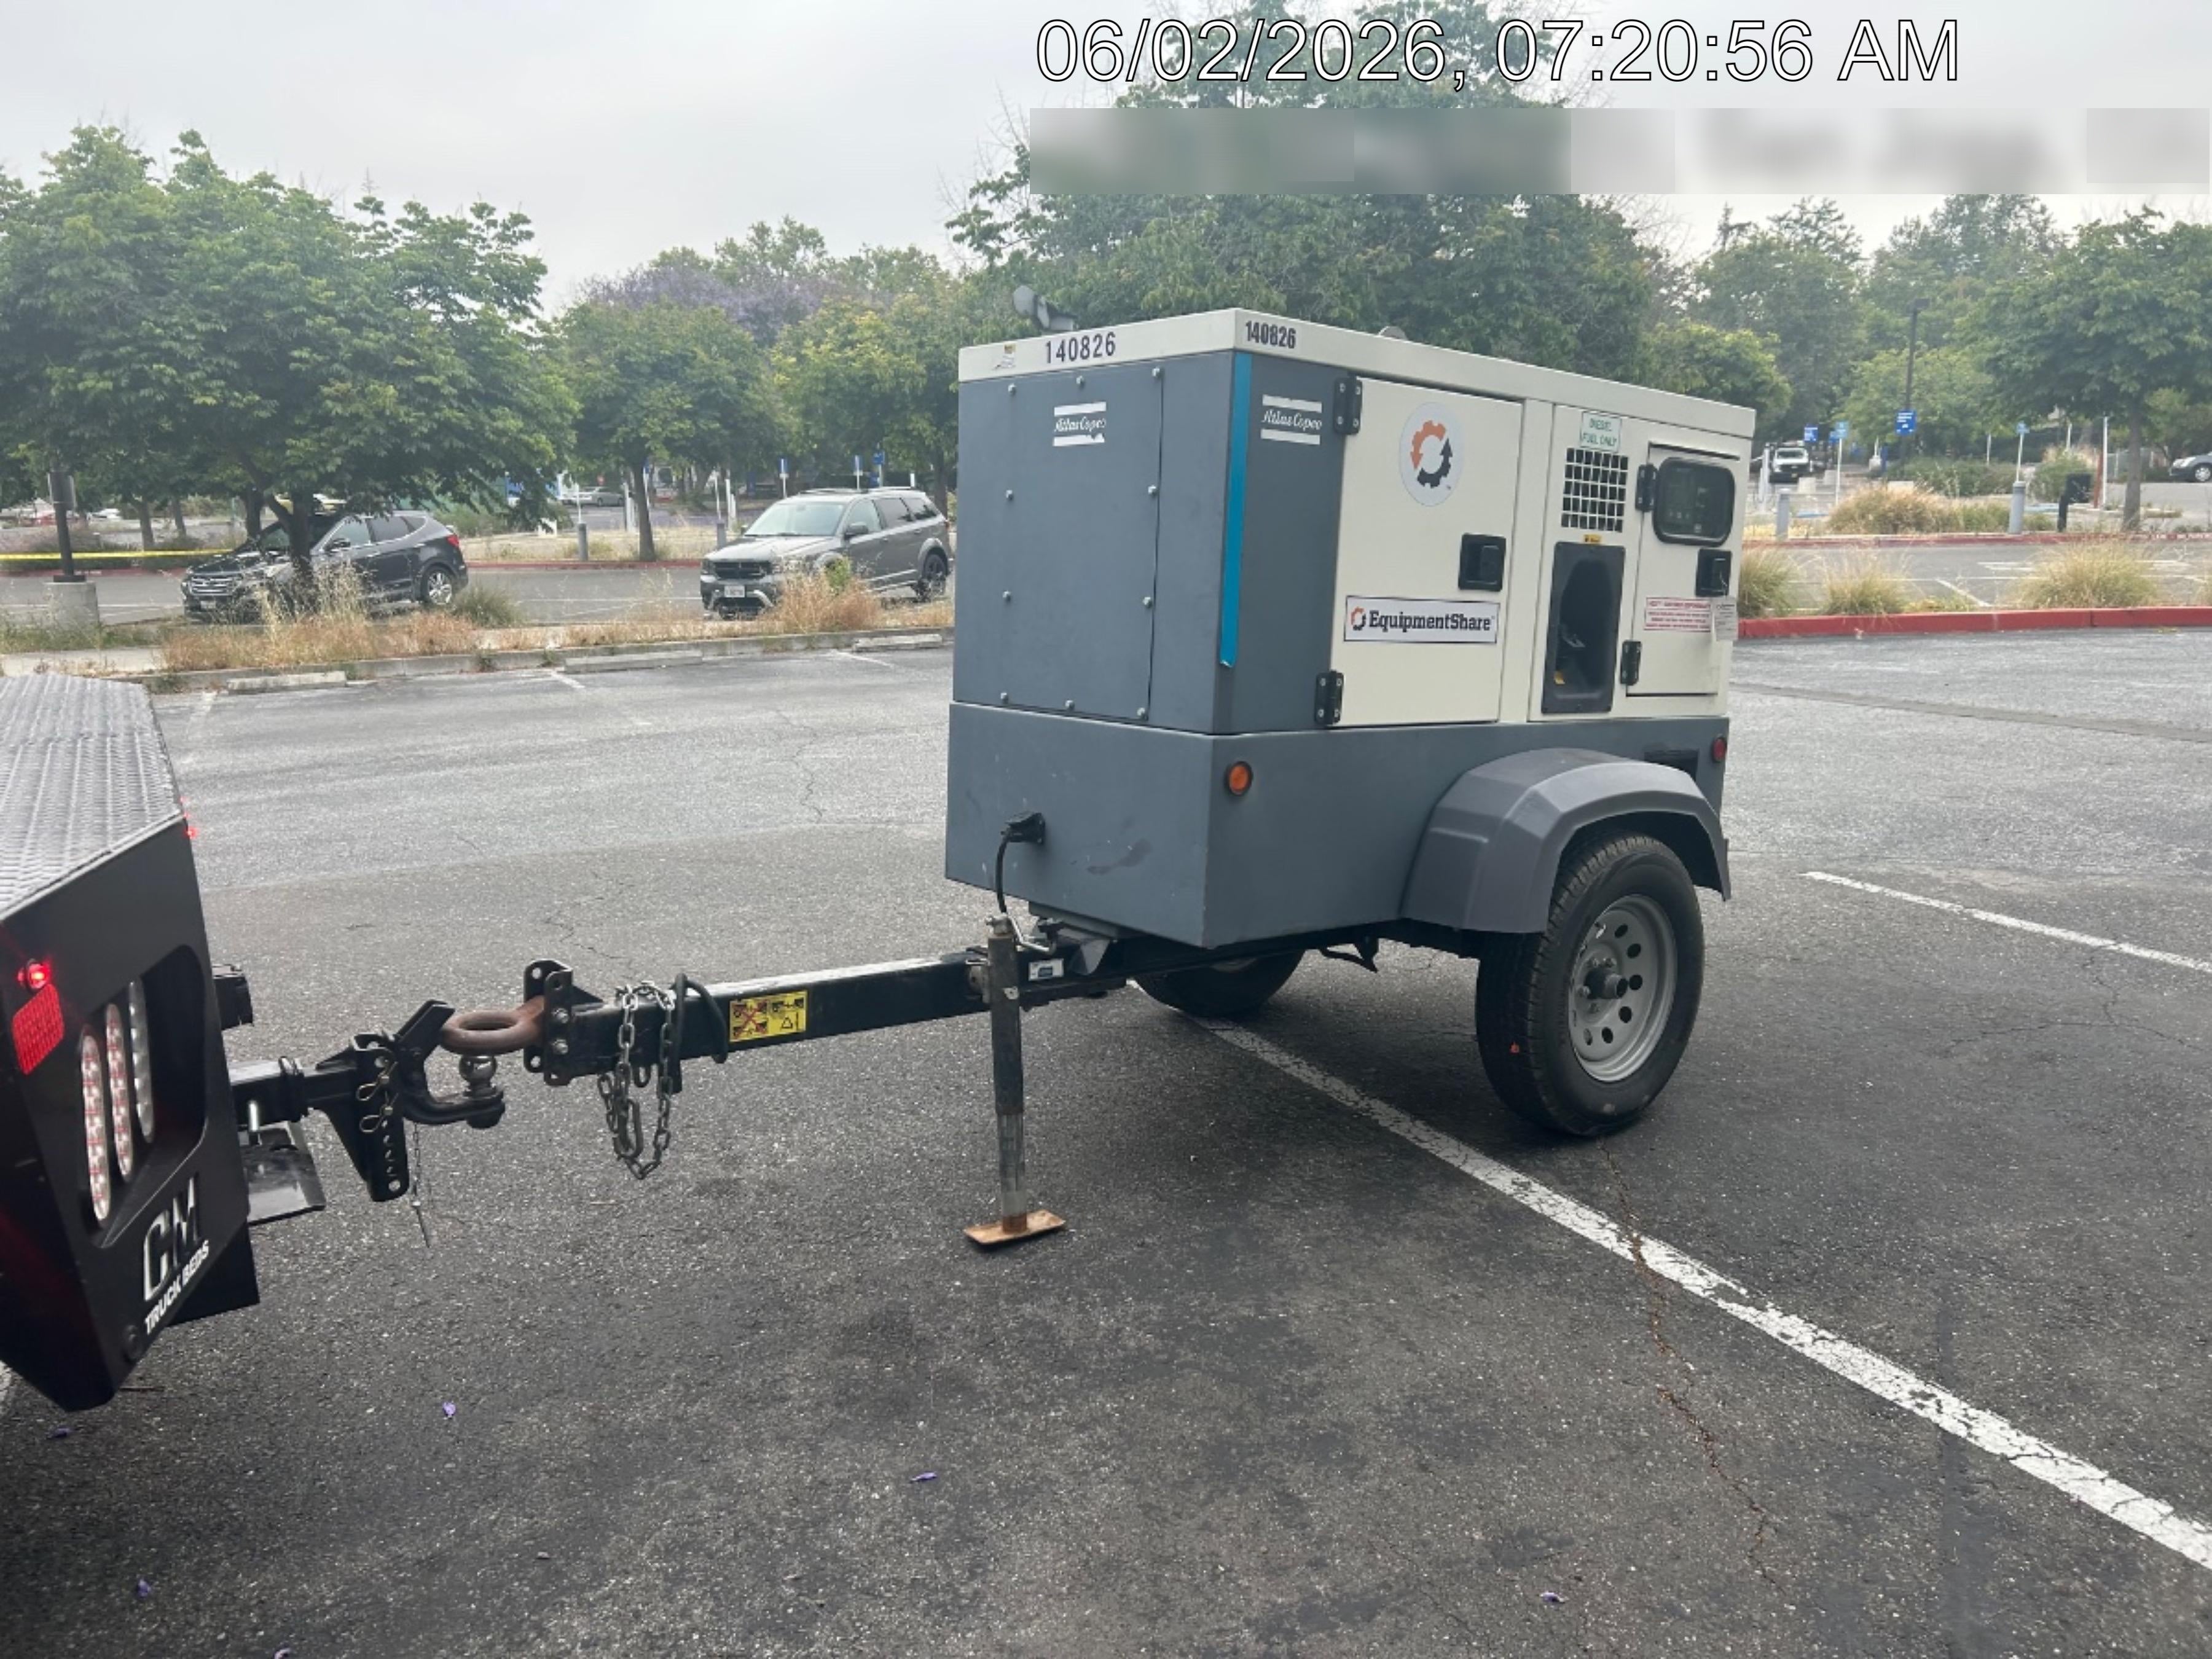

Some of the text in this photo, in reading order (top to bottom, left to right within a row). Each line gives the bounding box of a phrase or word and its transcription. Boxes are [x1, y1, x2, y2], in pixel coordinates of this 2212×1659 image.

[1046, 332, 1116, 364] 140826
[1246, 320, 1296, 349] 140826
[1261, 409, 1292, 426] Atlas
[1369, 610, 1491, 632] EquipmentShare
[144, 1176, 199, 1301] CM
[145, 1239, 209, 1335] TRUCK BEDS
